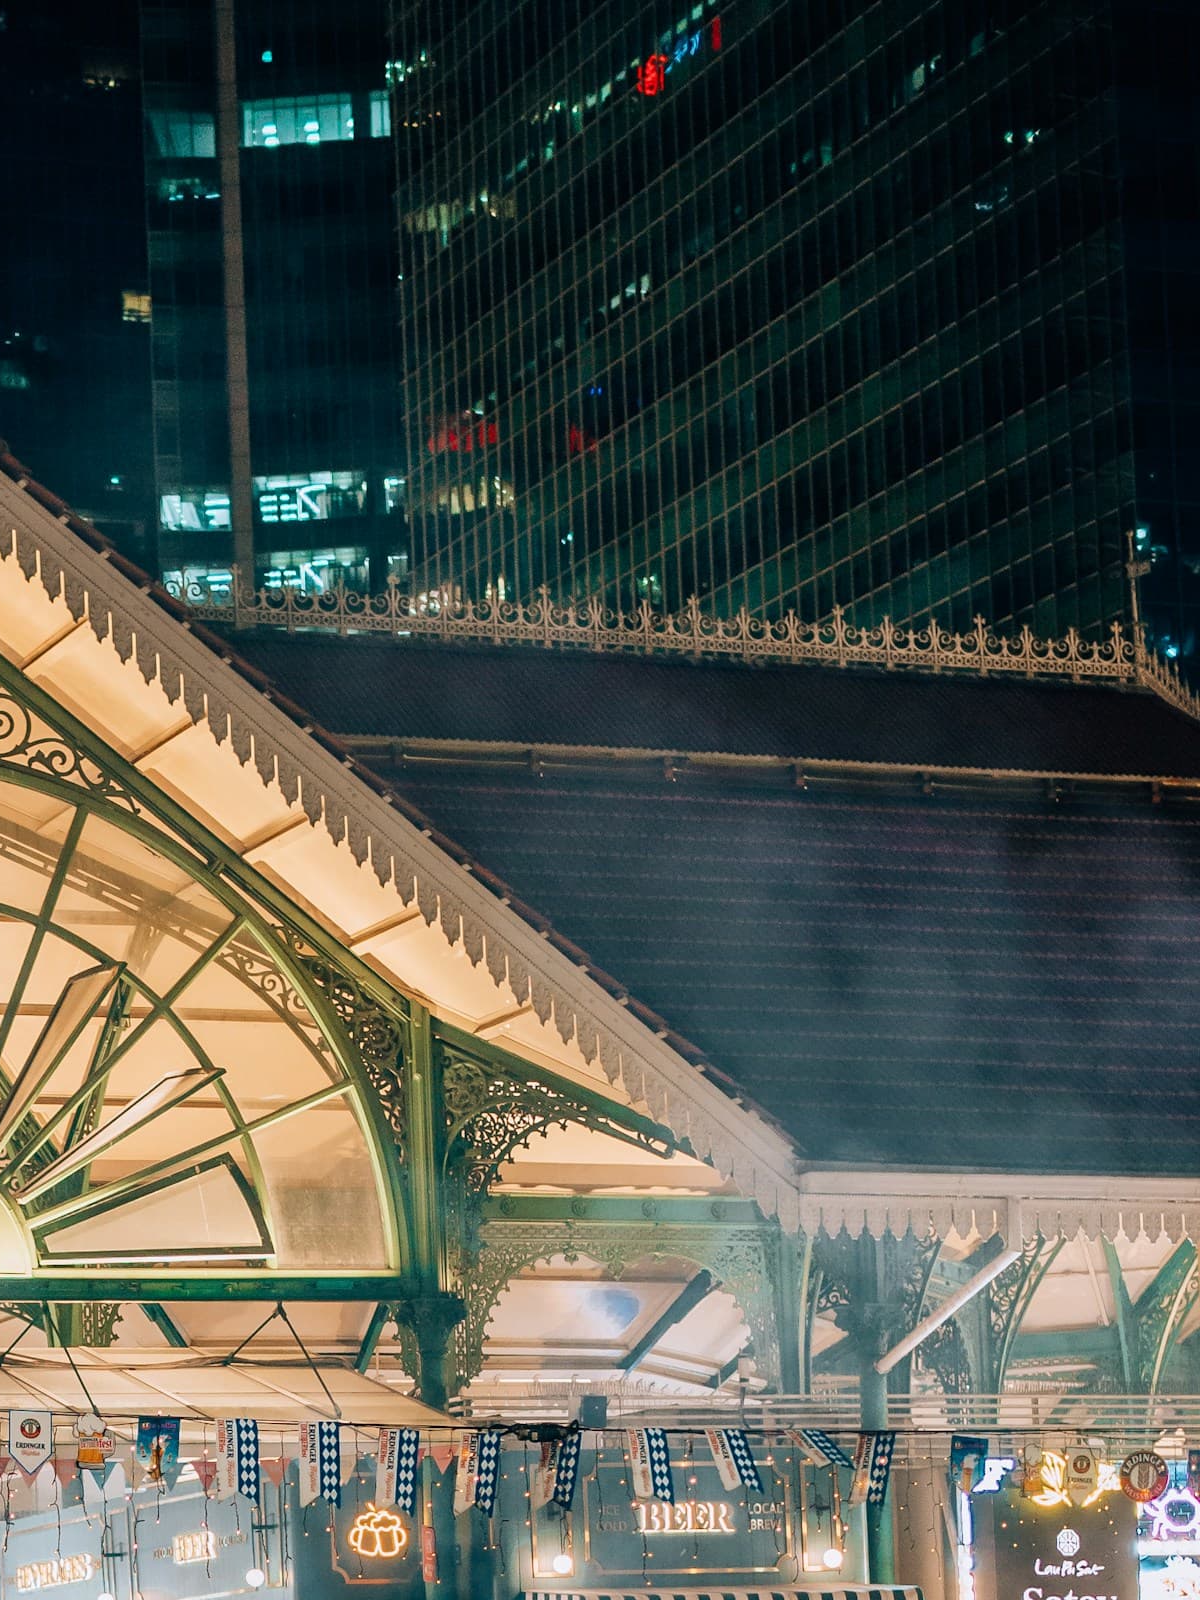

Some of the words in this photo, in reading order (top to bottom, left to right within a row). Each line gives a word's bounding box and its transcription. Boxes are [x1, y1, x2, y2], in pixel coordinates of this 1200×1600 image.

[15, 1441, 45, 1450] ERDINGER
[226, 1420, 234, 1459] ERDINGER
[308, 1424, 317, 1464] ERDINGER
[386, 1430, 397, 1471] ERDINGER
[636, 1429, 648, 1465] ERDINGER
[1122, 1453, 1165, 1474] ERDINGER
[638, 1502, 737, 1533] BEER
[749, 1502, 783, 1514] LOCAL
[749, 1518, 782, 1530] BREW
